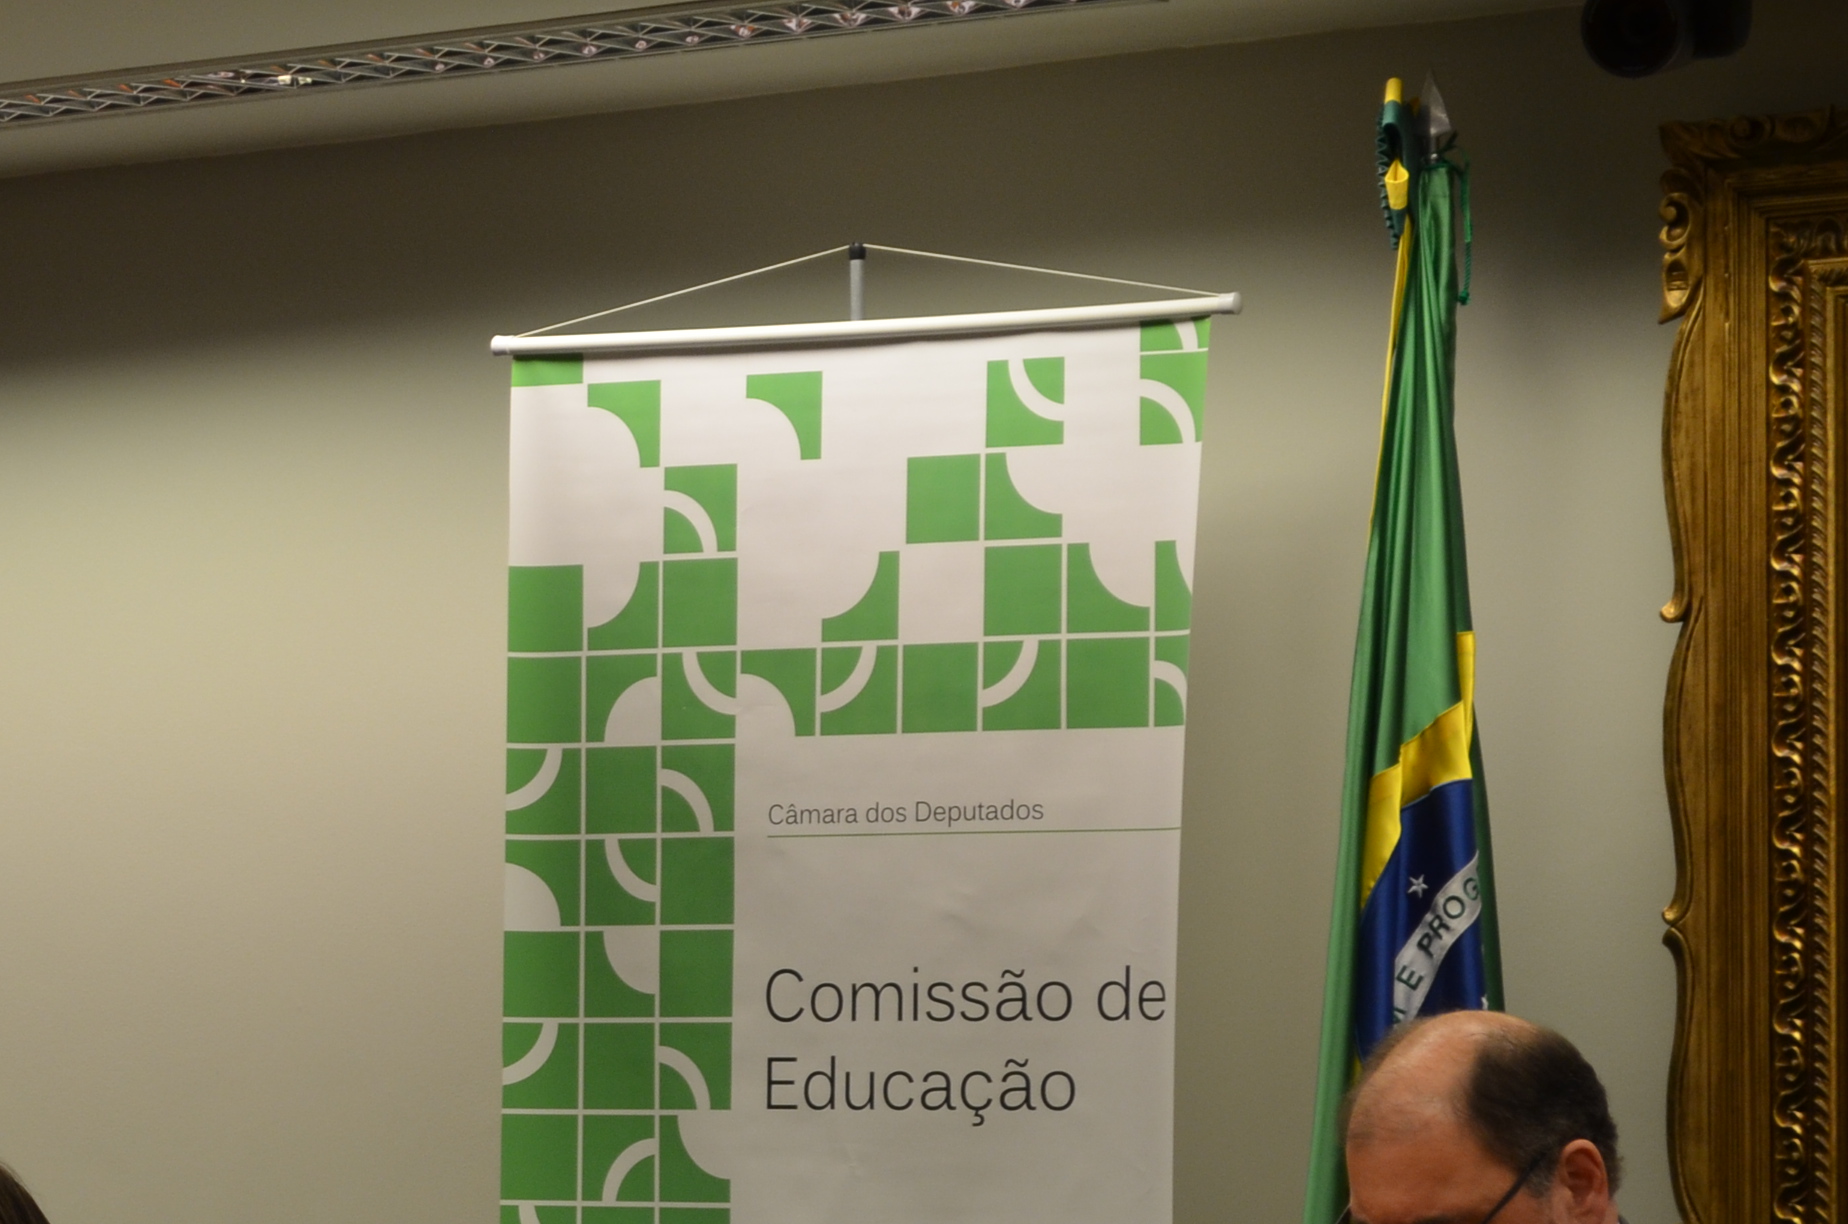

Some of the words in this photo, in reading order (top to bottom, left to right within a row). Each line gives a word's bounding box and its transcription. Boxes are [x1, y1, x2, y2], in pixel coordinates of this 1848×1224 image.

[767, 803, 859, 825] Câmara
[865, 802, 907, 824] dos
[915, 799, 1045, 827] Deputados
[765, 966, 1074, 1022] Comissão
[1097, 965, 1166, 1022] de
[1395, 965, 1424, 990] E
[765, 1055, 1076, 1127] Educação
